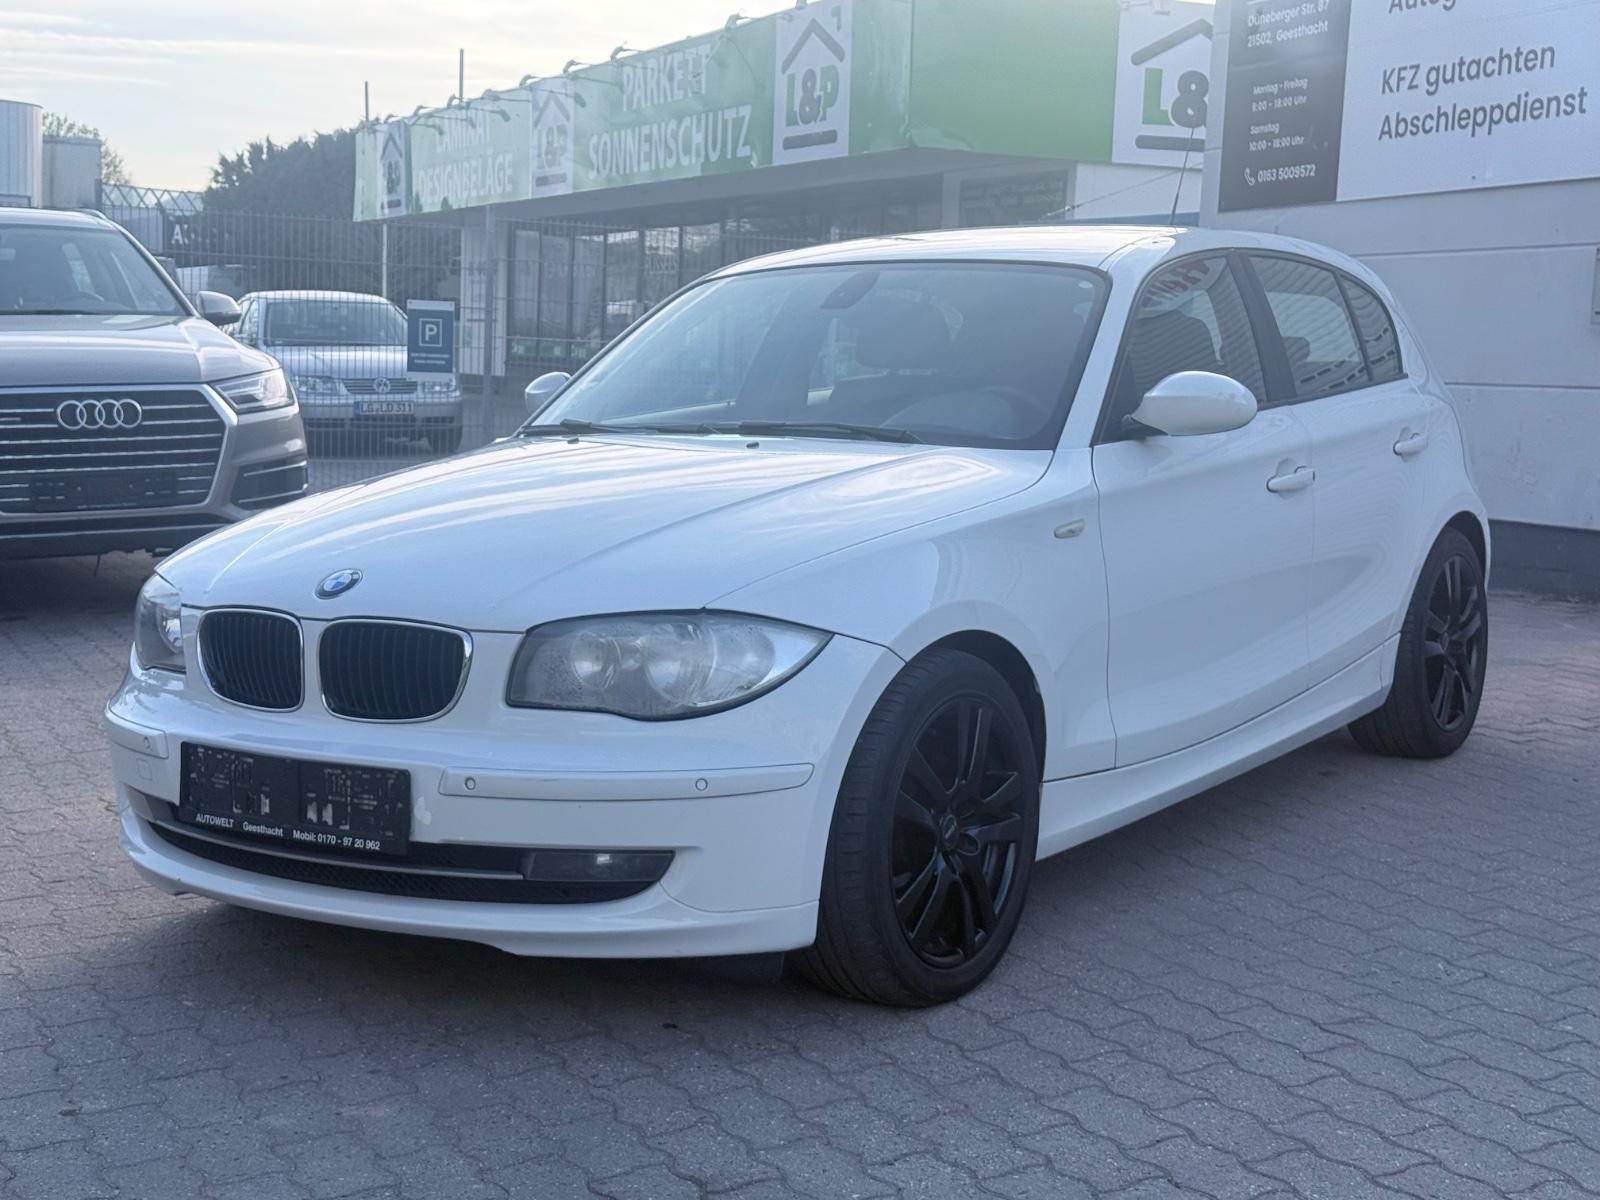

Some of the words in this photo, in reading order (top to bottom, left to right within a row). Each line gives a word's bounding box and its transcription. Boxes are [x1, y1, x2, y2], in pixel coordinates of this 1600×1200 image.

[1275, 20, 1329, 41] Geesthacht
[622, 43, 713, 112] PARKETT
[785, 64, 839, 127] L&P
[1381, 63, 1421, 95] KFZ
[1425, 46, 1556, 96] gutachten
[1378, 86, 1588, 141] Abschleppdienst
[588, 104, 752, 180] SONNENSCHUTZ
[418, 148, 514, 200] DESIGNBELÄGE
[1257, 168, 1277, 182] 0163
[1278, 164, 1316, 181] 5009572
[425, 323, 438, 342] P
[195, 813, 234, 828] AUTOWELT
[242, 821, 284, 837] Geesthacht
[293, 830, 317, 842] Mobil:
[317, 834, 337, 846] 0170
[342, 837, 354, 847] 97
[354, 838, 365, 848] 20
[365, 840, 381, 850] 962
